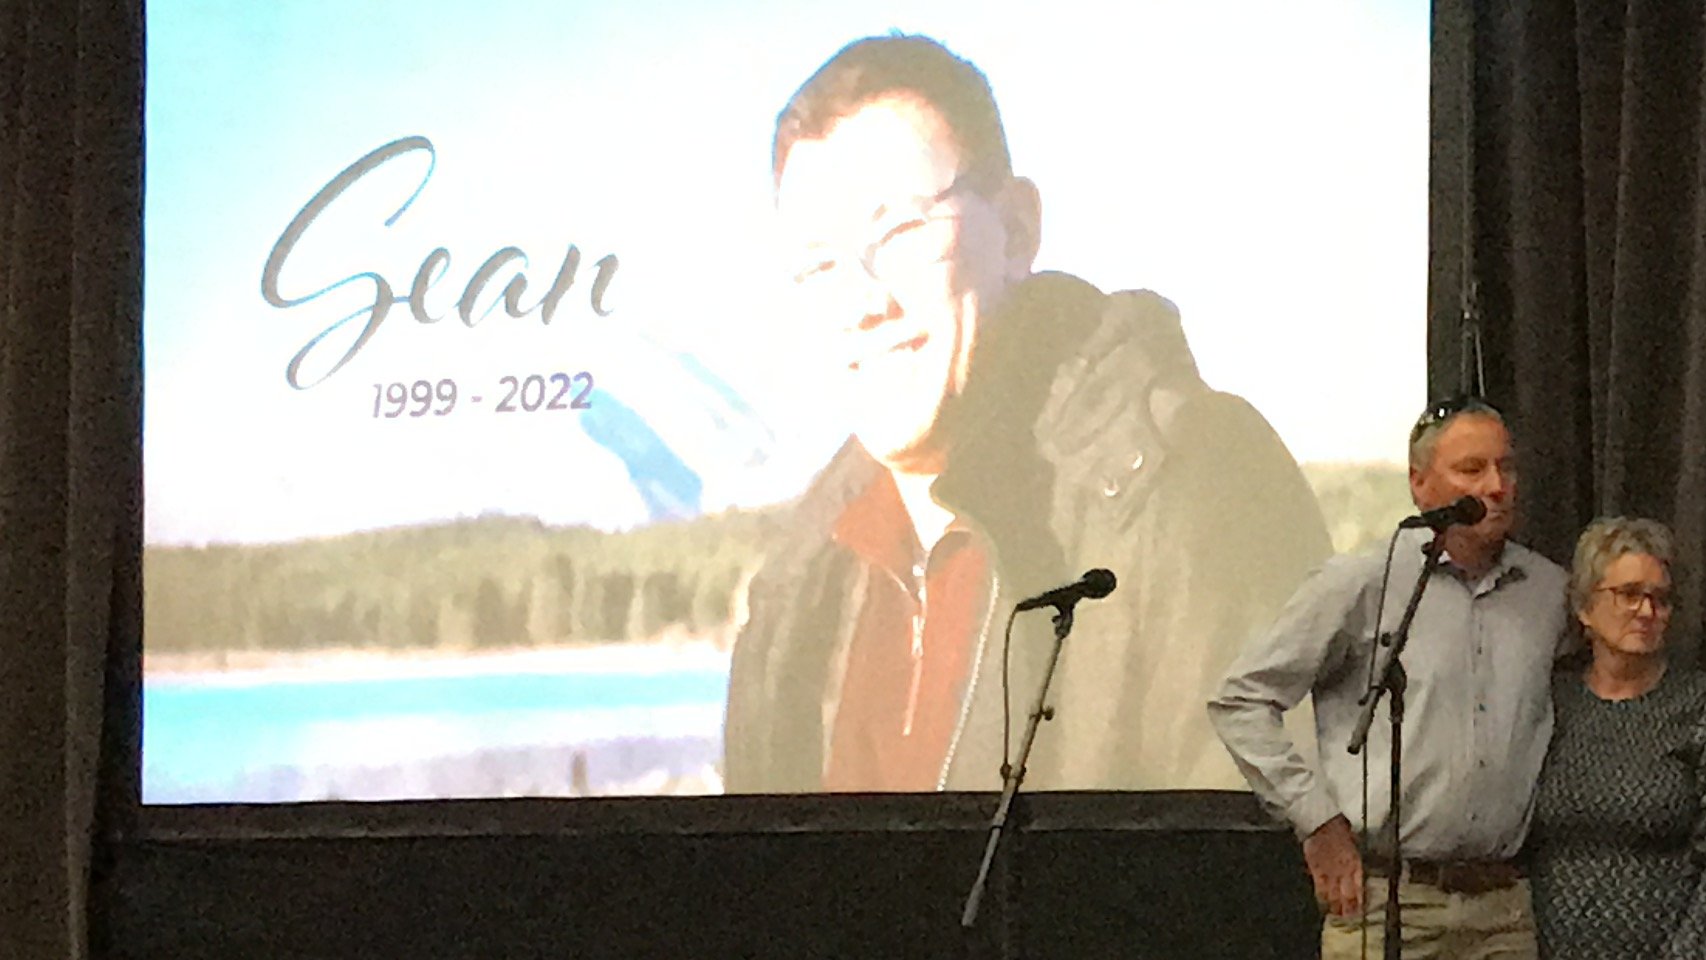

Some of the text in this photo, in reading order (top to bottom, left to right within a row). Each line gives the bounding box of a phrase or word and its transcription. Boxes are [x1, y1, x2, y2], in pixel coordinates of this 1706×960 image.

[261, 135, 619, 390] Sean
[373, 378, 458, 419] 1999
[495, 371, 594, 413] 2022
